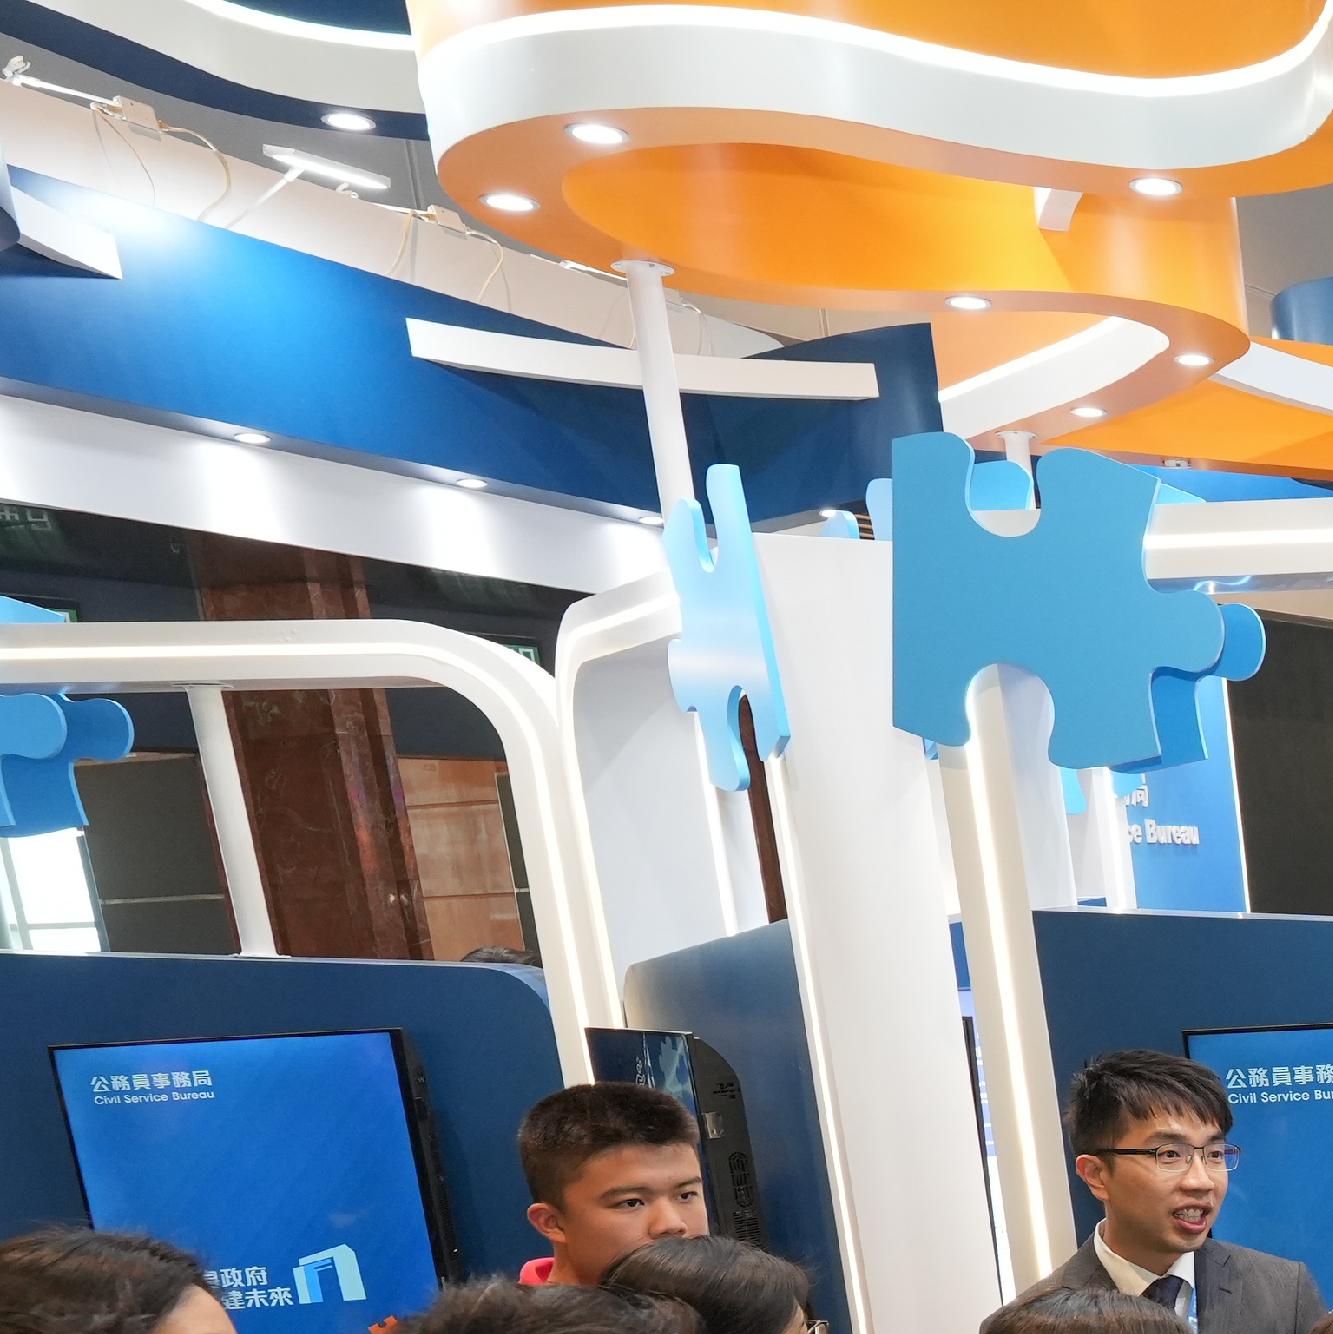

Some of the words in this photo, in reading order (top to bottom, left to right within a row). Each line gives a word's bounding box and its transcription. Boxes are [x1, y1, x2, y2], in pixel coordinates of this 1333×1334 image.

[1144, 819, 1200, 845] Bureau
[90, 1070, 213, 1092] 公務員事務局
[94, 1095, 121, 1105] Civil
[124, 1093, 169, 1104] Service
[172, 1090, 215, 1101] Bureau
[1228, 1093, 1257, 1104] Civil
[1260, 1090, 1310, 1103] Service
